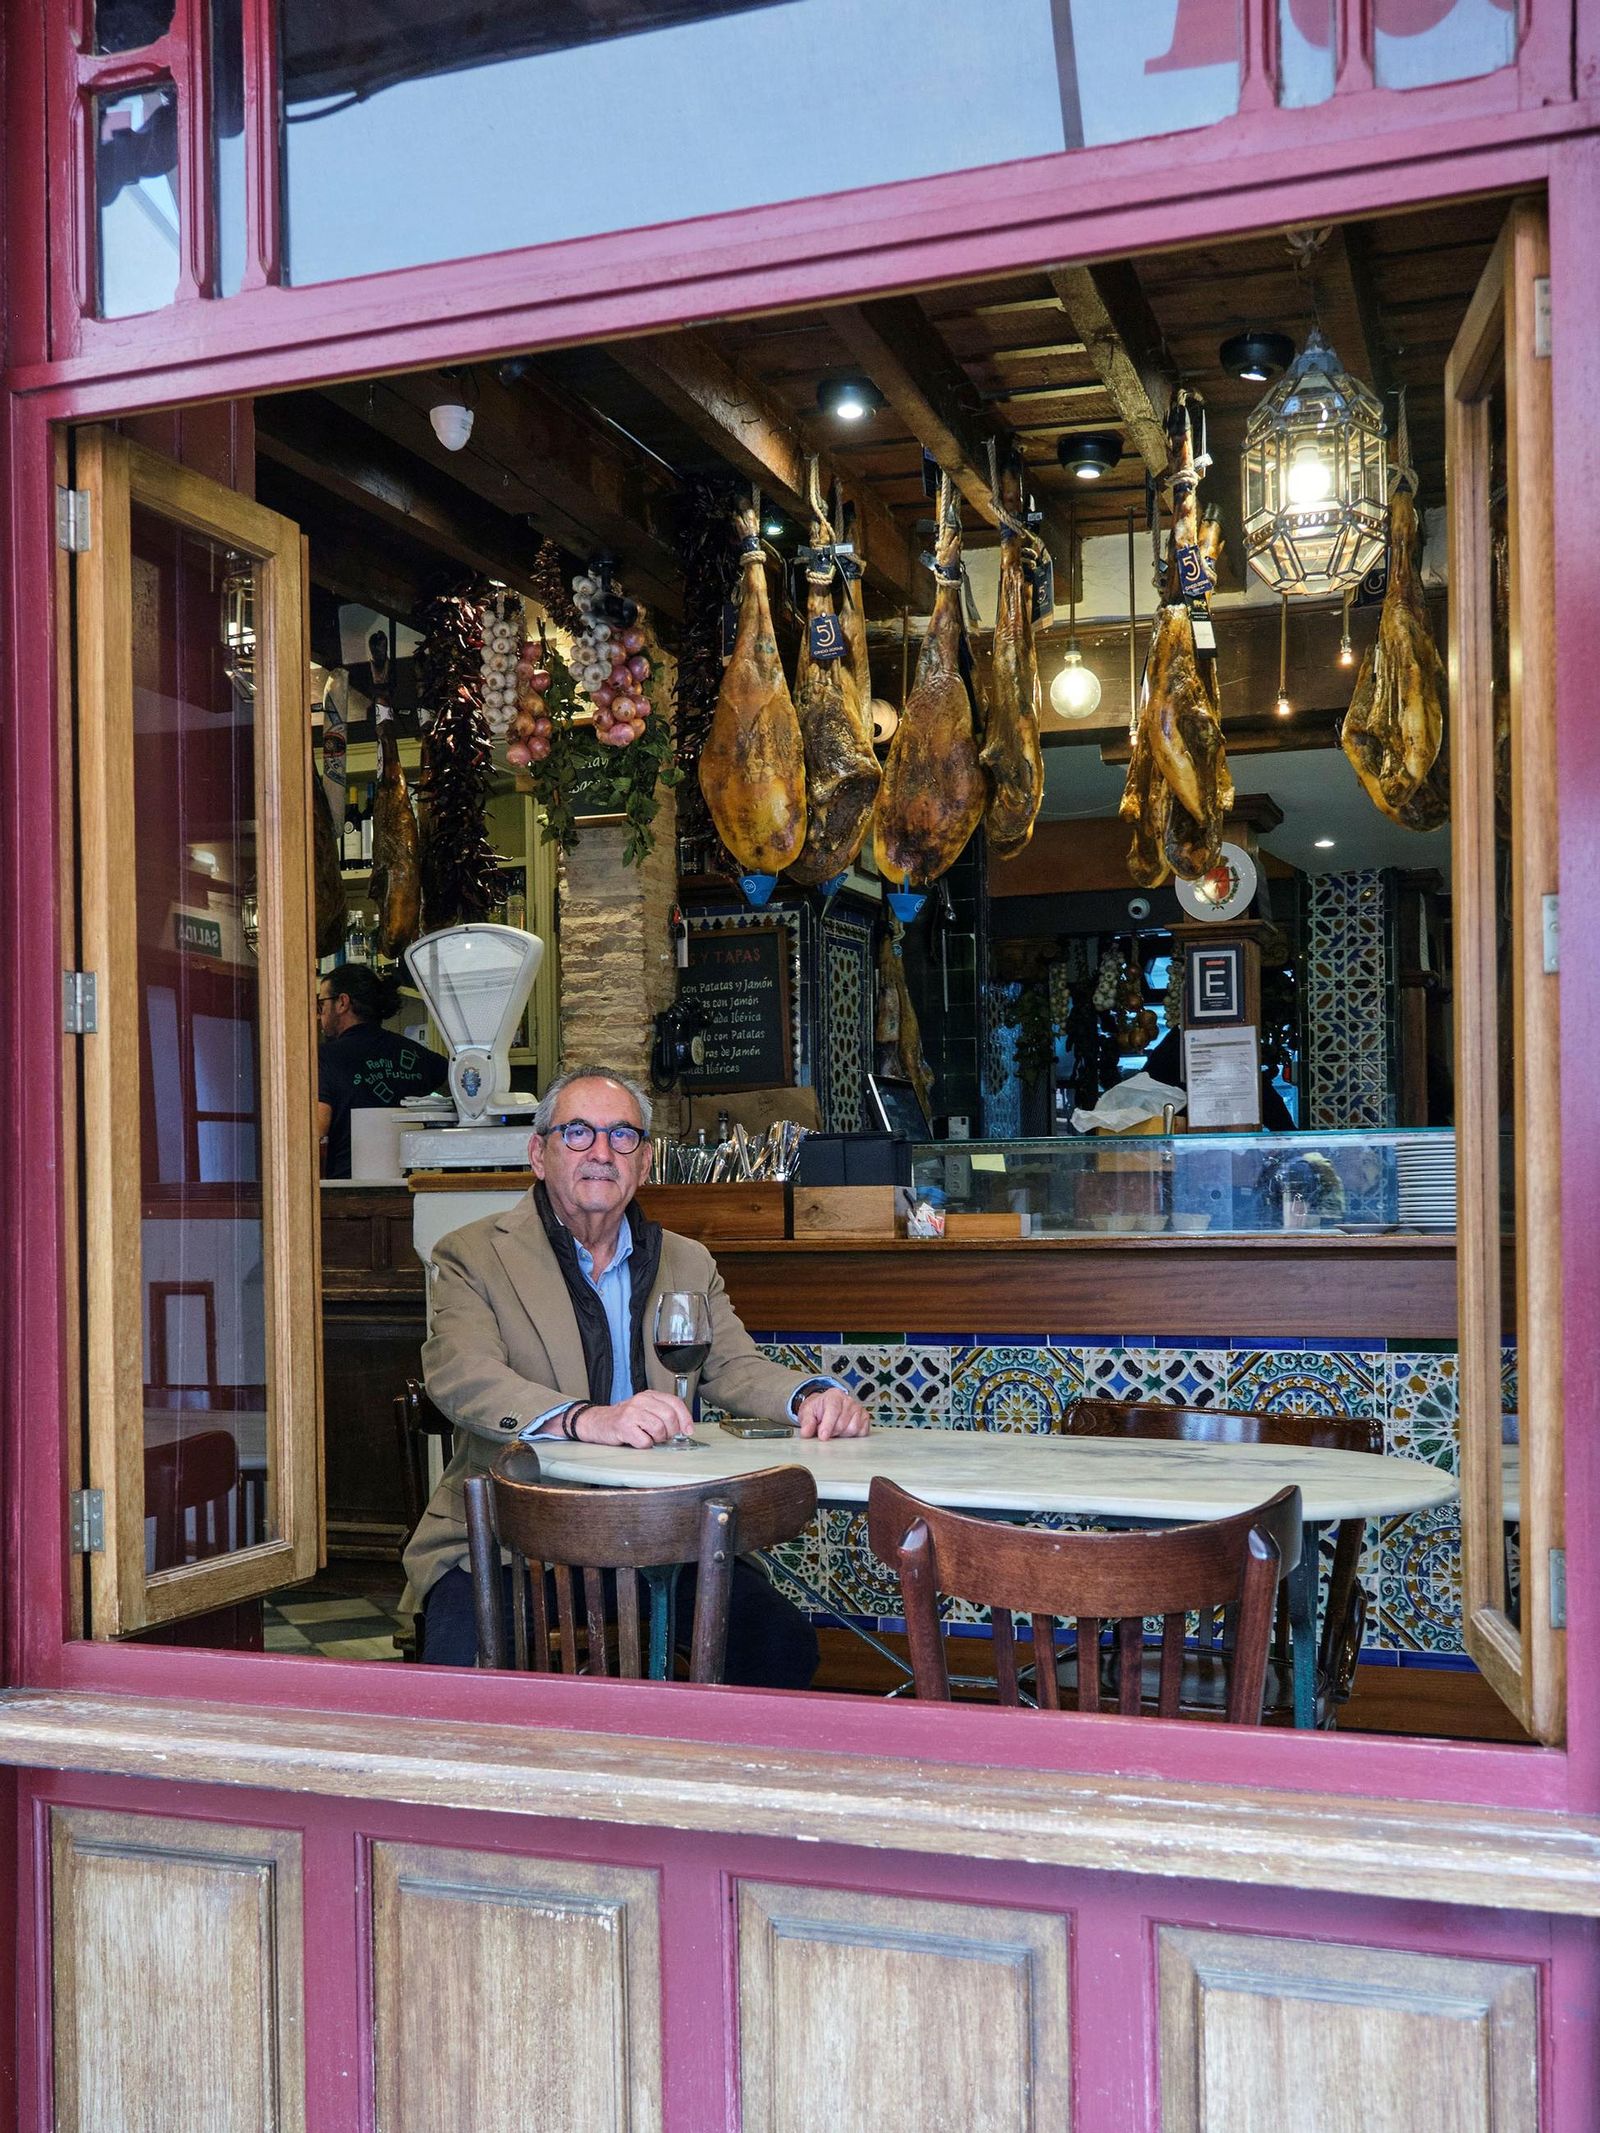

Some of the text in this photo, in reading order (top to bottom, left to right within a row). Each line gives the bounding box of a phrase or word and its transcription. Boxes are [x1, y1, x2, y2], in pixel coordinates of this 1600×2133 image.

[816, 619, 836, 647] 5J
[714, 947, 761, 964] TAPAS
[681, 985, 697, 994] con
[700, 981, 733, 993] Patatas
[743, 976, 773, 993] Jamón
[712, 999, 728, 1008] con
[731, 1009, 762, 1024] Ibérica
[713, 1033, 729, 1041] con
[731, 1029, 766, 1040] Patatas
[385, 1068, 423, 1081] Future
